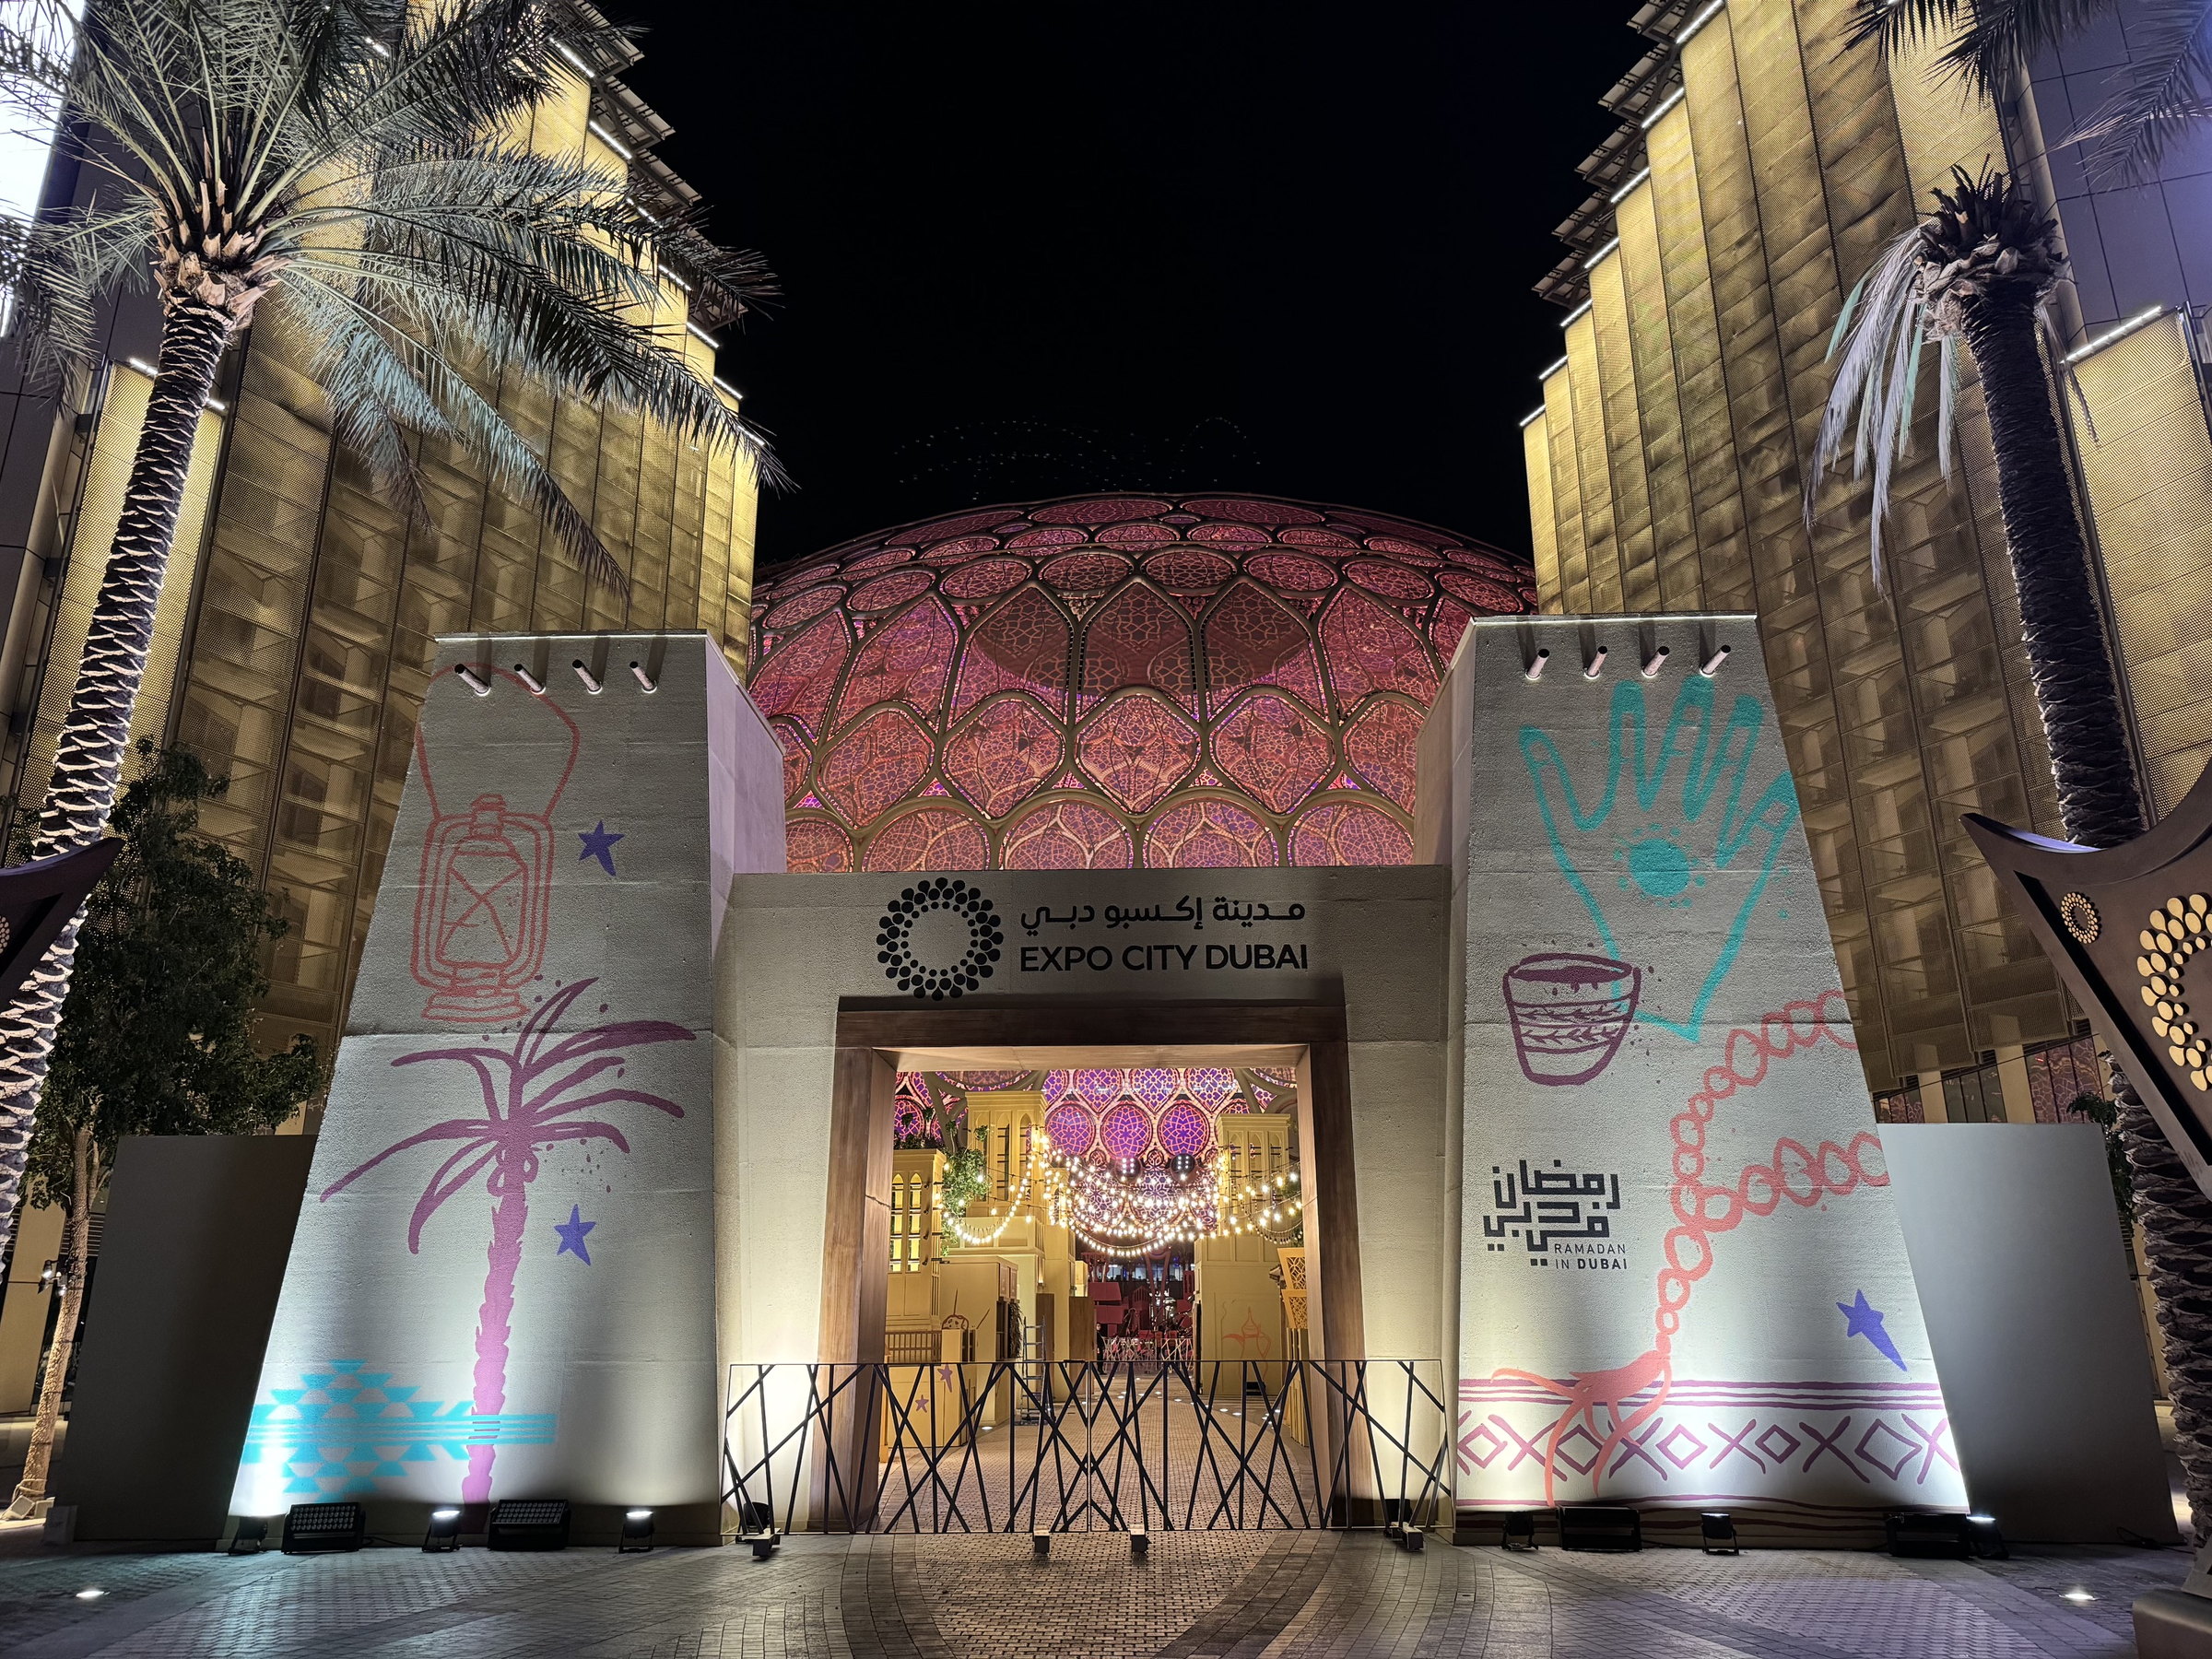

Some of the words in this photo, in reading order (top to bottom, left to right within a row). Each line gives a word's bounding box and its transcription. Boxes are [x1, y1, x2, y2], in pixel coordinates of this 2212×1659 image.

[1020, 905, 1095, 936] دبي
[1104, 895, 1204, 930] إكسبو
[1213, 896, 1306, 928] مدينة
[1019, 945, 1113, 972] EXPO
[1122, 945, 1198, 971] CITY
[1206, 944, 1309, 971] DUBAI
[1491, 1159, 1621, 1210] رمضان
[1554, 1243, 1627, 1254] RAMADAN
[1555, 1258, 1571, 1270] IN
[1577, 1258, 1628, 1270] DUBAI
